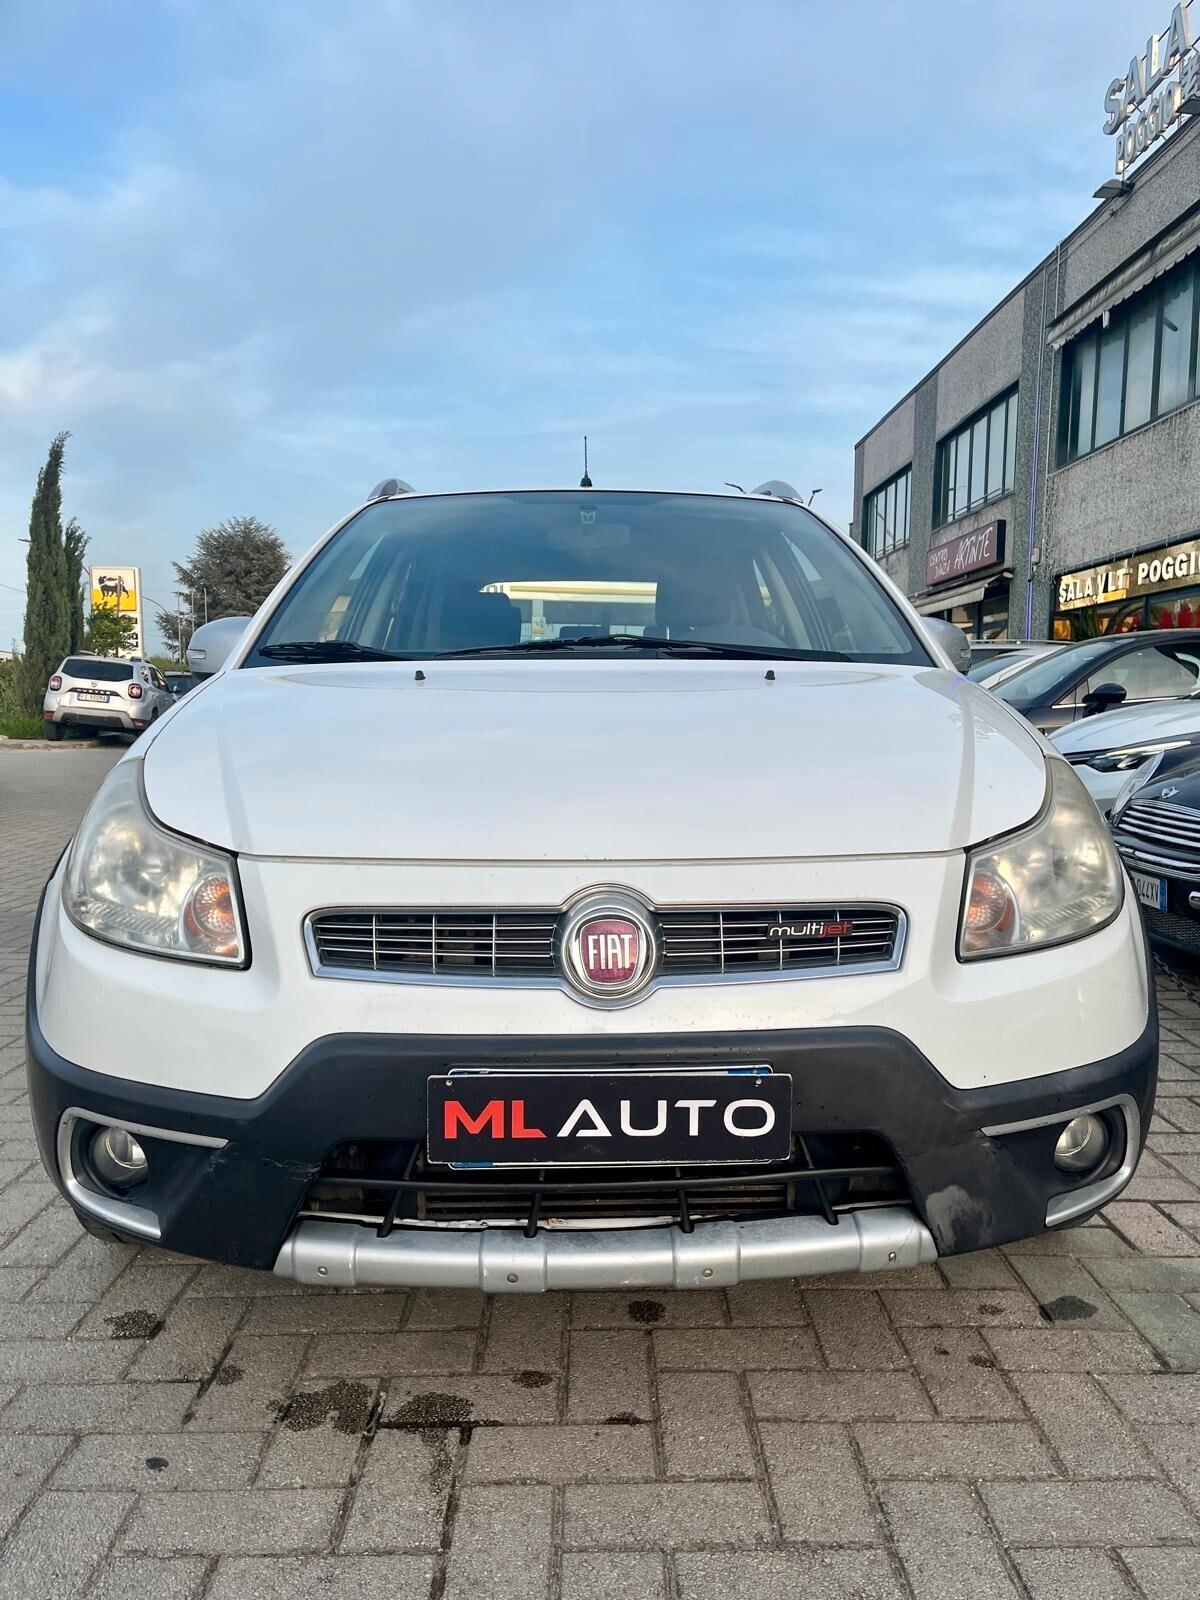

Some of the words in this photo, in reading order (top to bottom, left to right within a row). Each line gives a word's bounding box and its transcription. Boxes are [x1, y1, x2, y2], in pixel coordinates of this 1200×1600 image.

[1103, 2, 1192, 135] SALA
[1115, 81, 1182, 174] POGGIO
[929, 548, 948, 566] CENTRO
[1059, 576, 1093, 603] SALA
[1137, 551, 1200, 586] POGGI
[769, 921, 852, 939] multijet
[588, 933, 634, 970] FIAT
[444, 1100, 547, 1139] ML
[556, 1099, 776, 1137] AUTO
